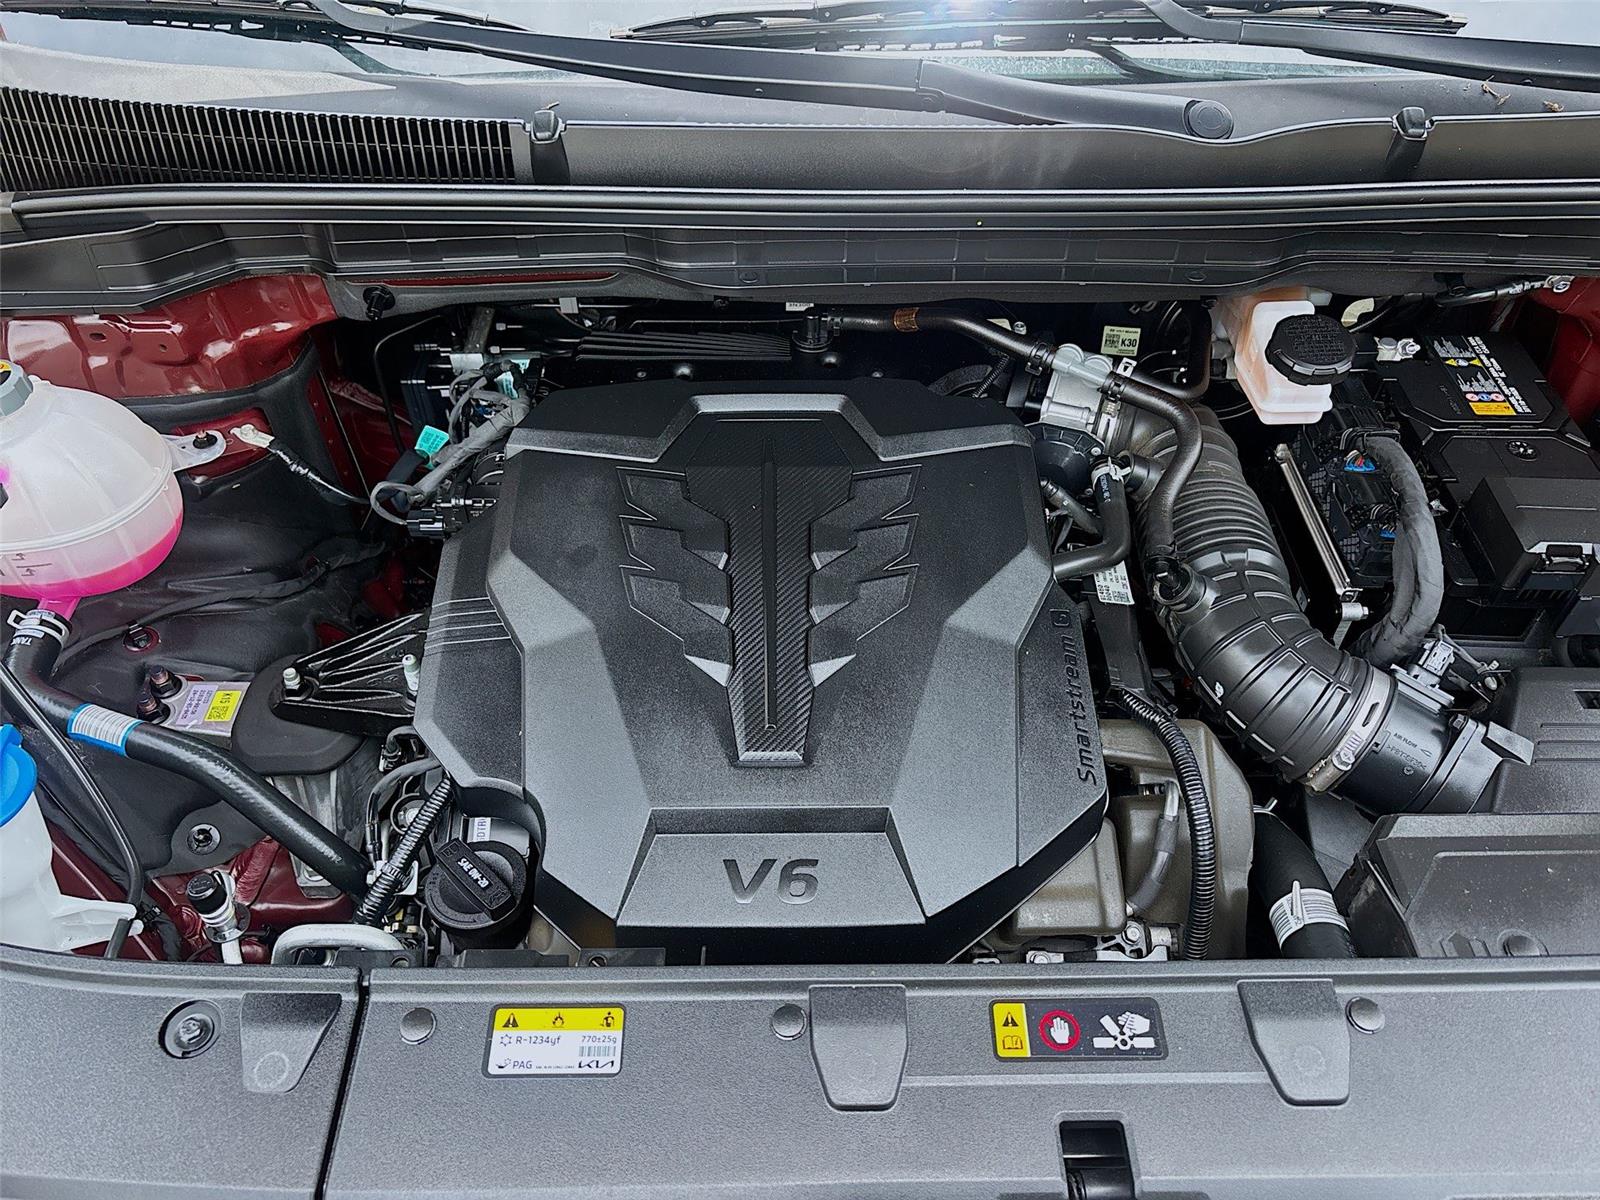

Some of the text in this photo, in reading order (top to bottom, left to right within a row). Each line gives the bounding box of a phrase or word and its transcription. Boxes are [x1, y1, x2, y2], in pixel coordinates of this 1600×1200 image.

[1120, 338, 1138, 347] K30
[1060, 633, 1097, 787] Smartstream
[458, 858, 489, 888] SAE 0W-20
[722, 859, 820, 905] V6
[515, 1035, 561, 1046] R-1234yf
[512, 1060, 533, 1069] PAG
